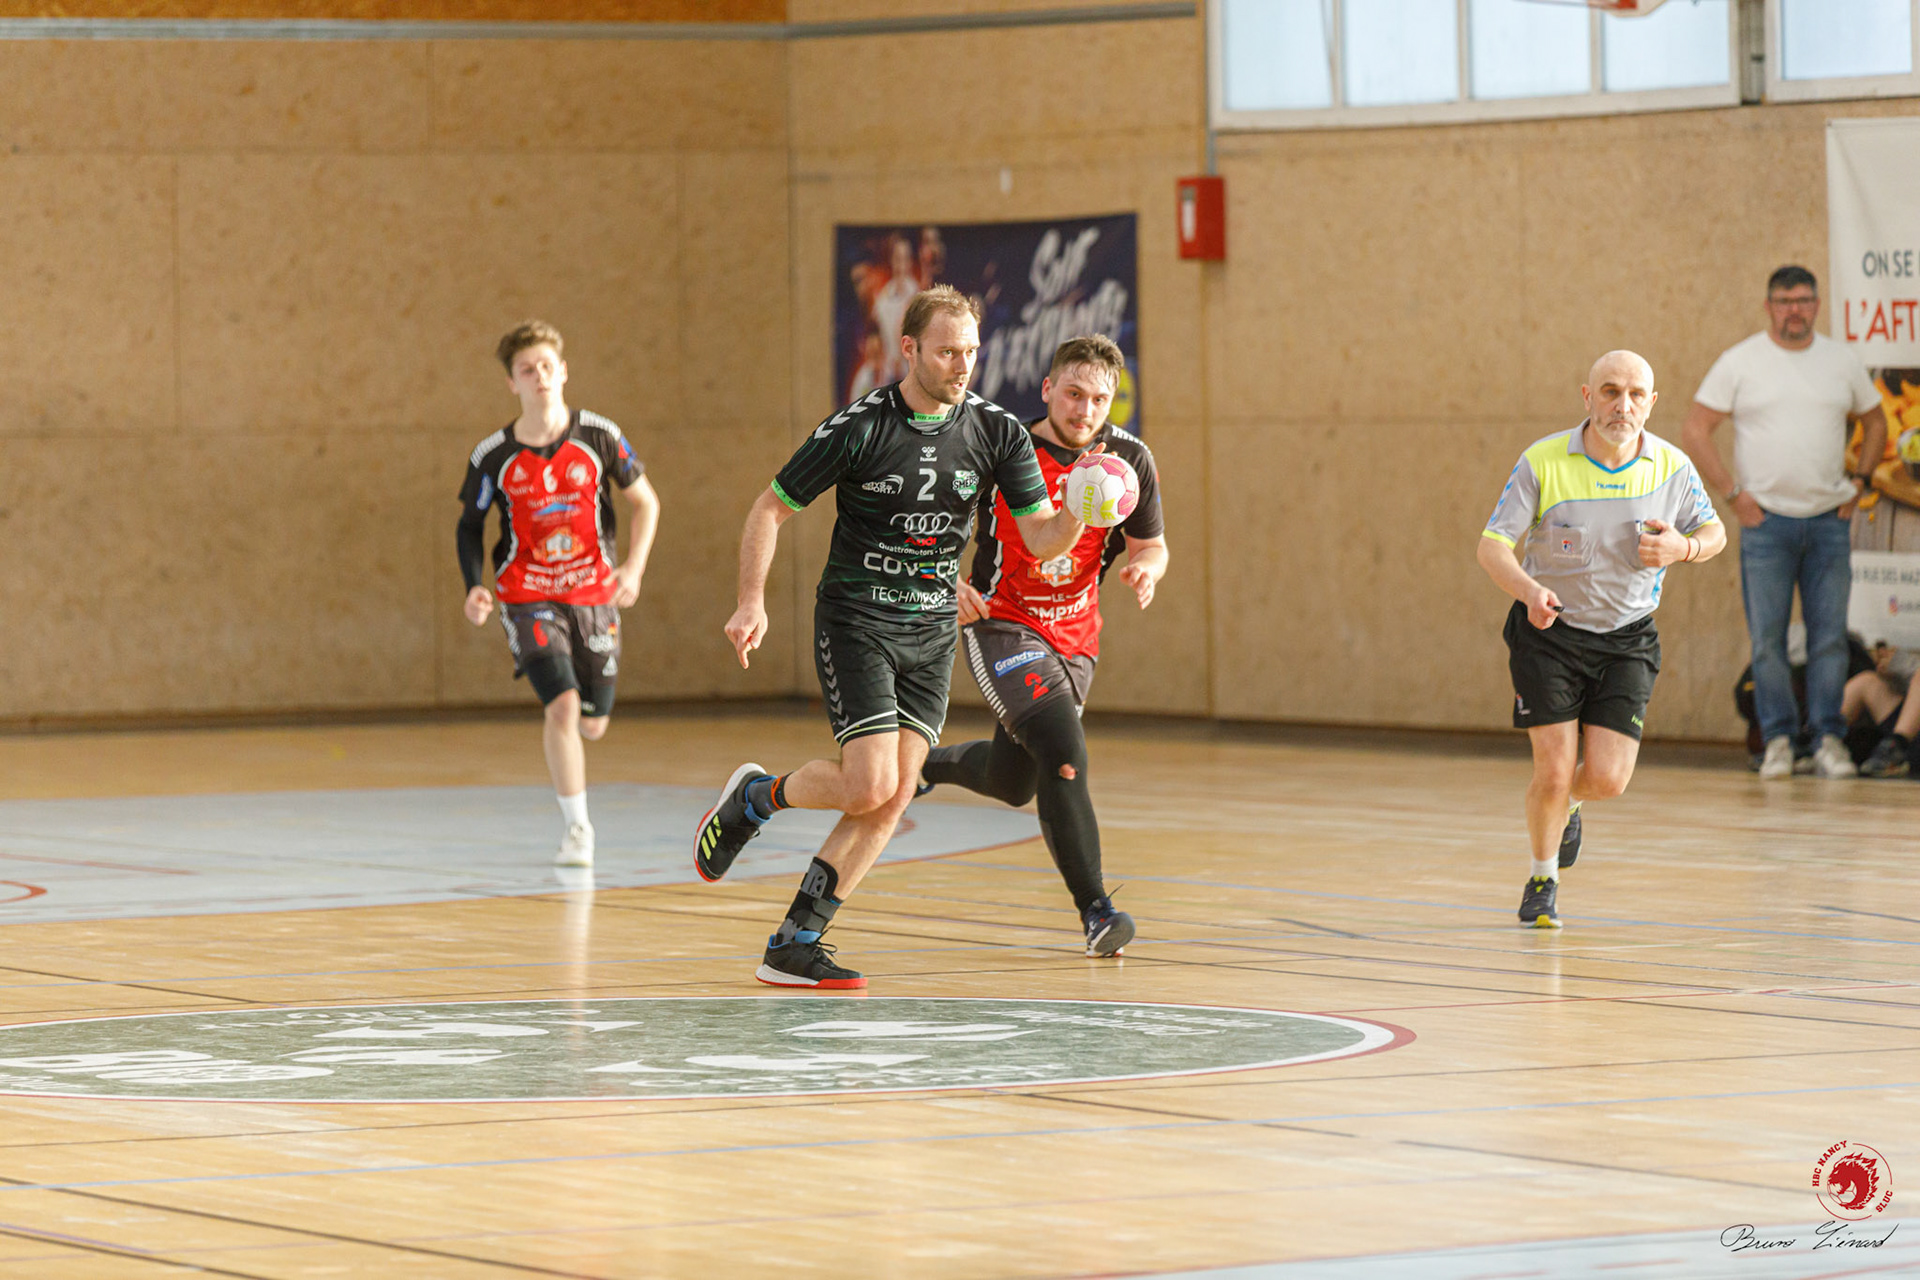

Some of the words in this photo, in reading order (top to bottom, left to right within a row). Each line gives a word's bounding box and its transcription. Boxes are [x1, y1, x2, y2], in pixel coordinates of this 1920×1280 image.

[1861, 249, 1889, 278] ON
[1893, 249, 1914, 278] SE
[1844, 298, 1920, 343] L'AFT
[542, 464, 559, 493] 6
[916, 468, 938, 502] 2
[1595, 480, 1626, 491] hummel
[878, 542, 934, 556] Quattromotors
[904, 536, 937, 547] Audi
[1051, 593, 1066, 603] LE
[532, 620, 548, 647] 6
[1024, 672, 1049, 700] 2
